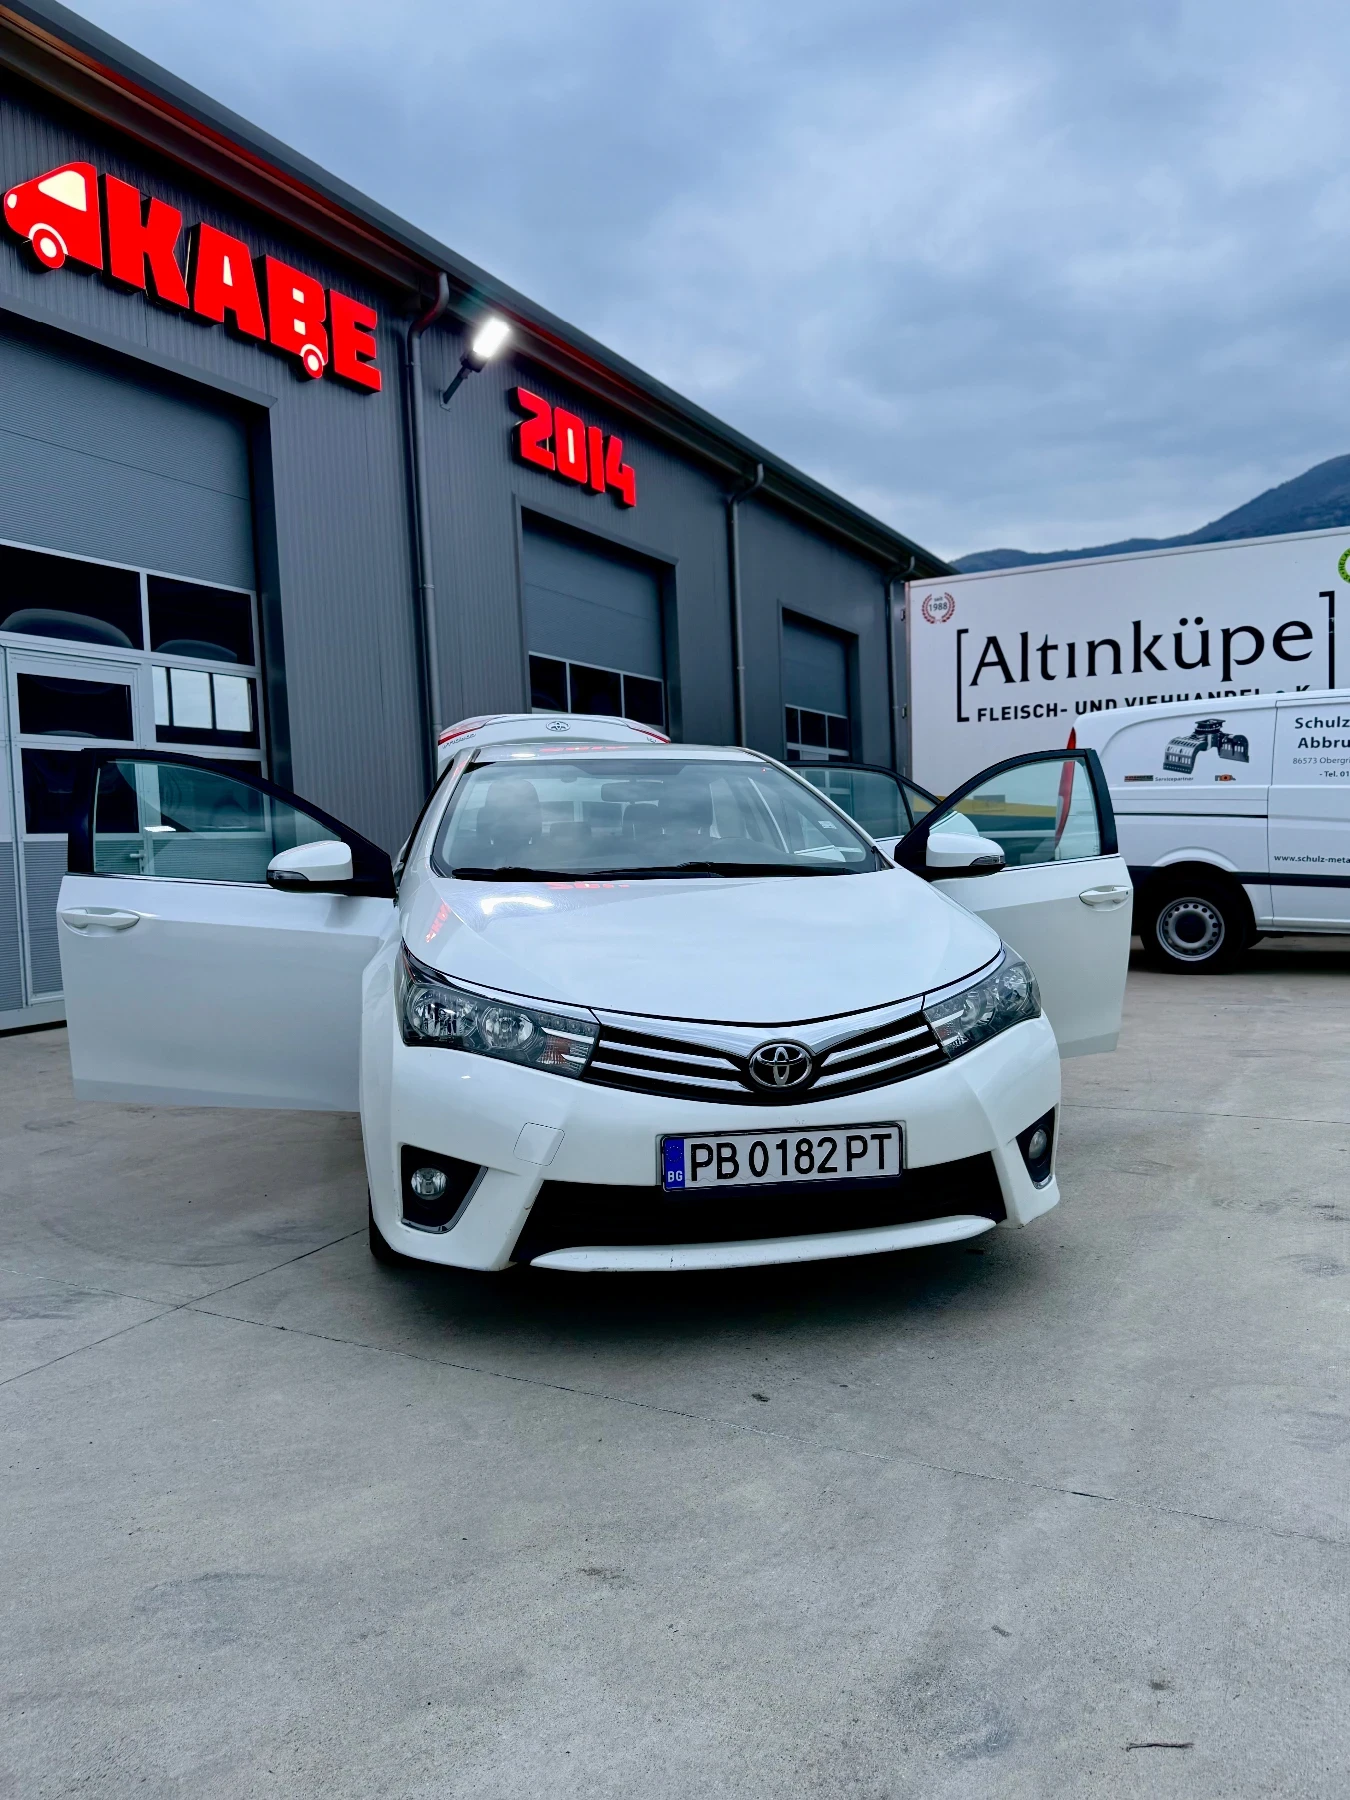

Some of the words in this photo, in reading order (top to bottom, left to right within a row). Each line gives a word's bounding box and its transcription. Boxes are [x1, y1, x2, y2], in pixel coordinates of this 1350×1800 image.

[510, 386, 636, 507] 2014
[929, 601, 948, 611] 1988
[977, 702, 1068, 722] FLEISCH-
[1075, 698, 1117, 715] UND
[1294, 716, 1350, 729] Schulz
[1324, 770, 1338, 778] Tel.
[690, 1142, 740, 1182] PB
[748, 1136, 838, 1178] 0182
[846, 1133, 893, 1172] PT
[667, 1170, 683, 1183] BG
